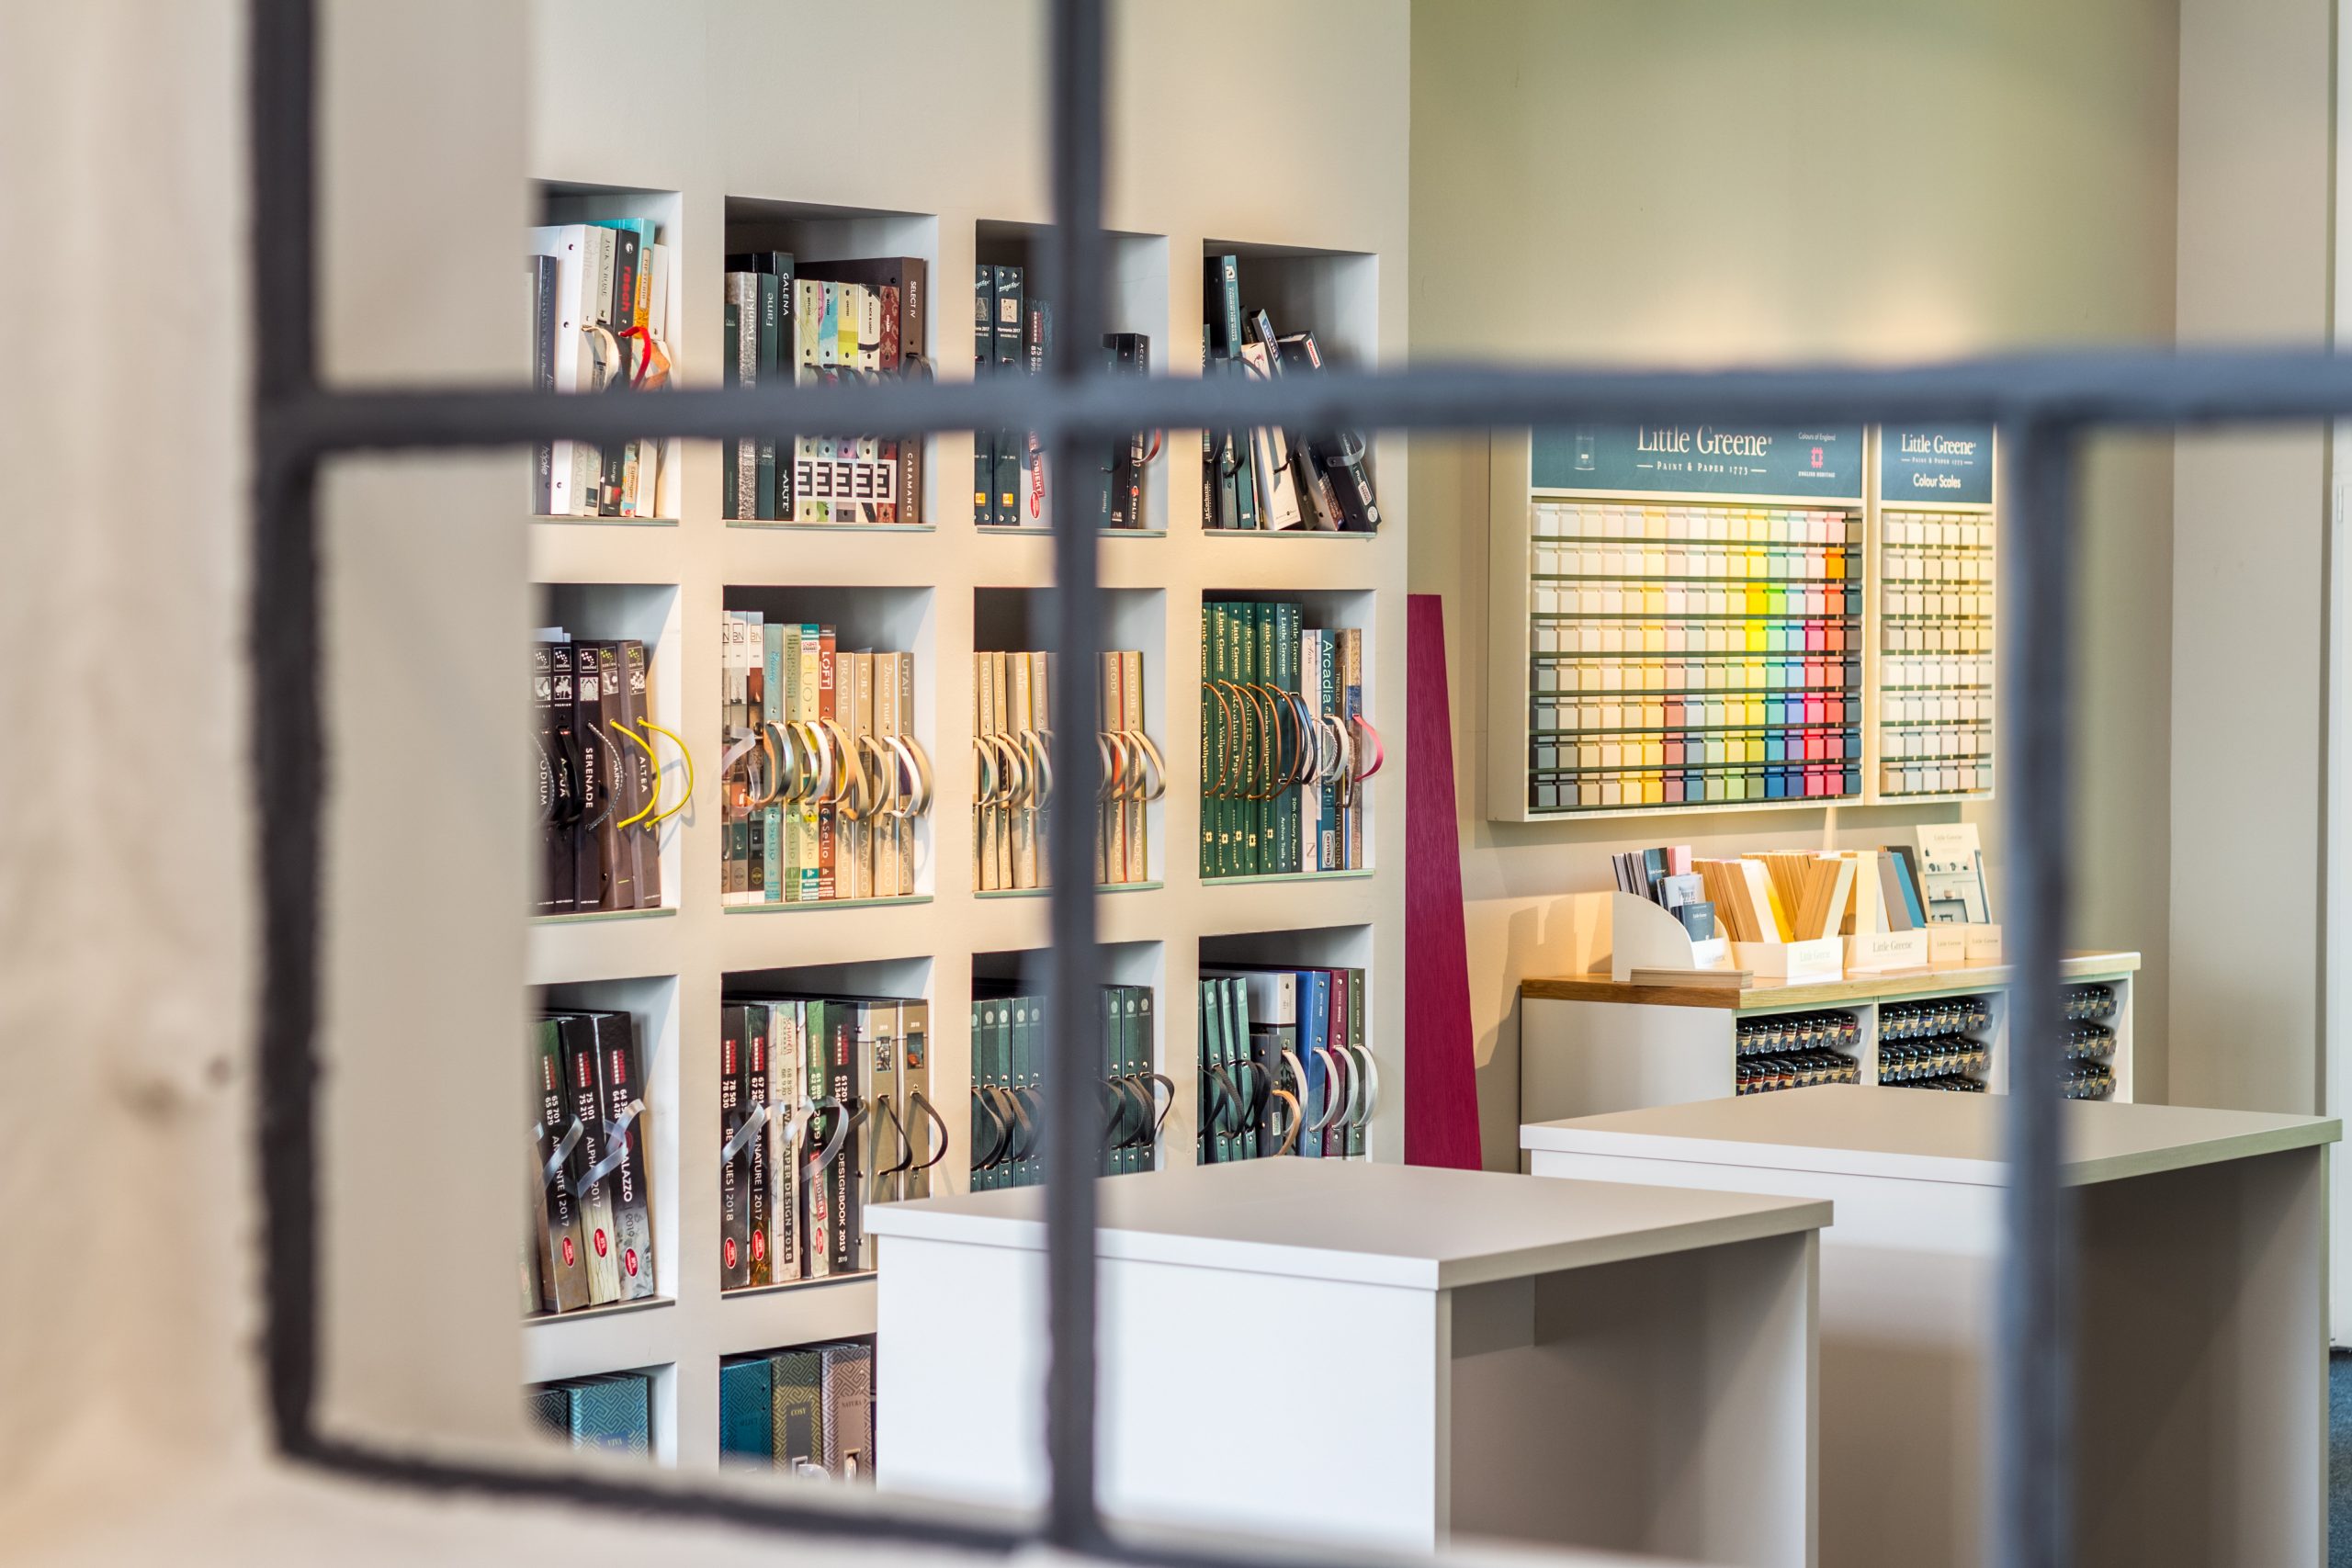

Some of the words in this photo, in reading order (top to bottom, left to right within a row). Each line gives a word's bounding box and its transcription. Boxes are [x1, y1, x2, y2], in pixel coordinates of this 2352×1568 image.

[782, 272, 790, 317] GALENA
[746, 290, 756, 341] Twinkle
[765, 292, 775, 327] Fame
[1031, 345, 1037, 356] 85
[1637, 424, 1690, 454] Little
[1798, 432, 1814, 440] Colours
[1820, 434, 1837, 442] England
[1901, 434, 1931, 454] Little
[1933, 434, 1973, 456] Greene
[906, 452, 914, 518] CASAMANCE
[1913, 472, 1938, 488] Colour
[1939, 472, 1962, 489] Scales
[821, 651, 831, 686] LOFT
[1322, 639, 1334, 686] Arcadia
[801, 656, 818, 702] duo
[841, 660, 850, 714] PRAGUE
[901, 658, 910, 697] UTAH
[982, 660, 990, 721] EQUINOXE
[1263, 735, 1272, 780] Wallpapers
[585, 748, 594, 808] SERENADE
[639, 756, 648, 794] ALTEA
[882, 826, 892, 888] CASADECO
[900, 826, 910, 887] CASADECO
[1114, 817, 1123, 875] CASADECO
[1133, 817, 1142, 875] CASADECO
[841, 829, 849, 892] CASADECO
[861, 830, 869, 892] CASADECO
[1872, 941, 1890, 953] Little
[1891, 939, 1914, 951] Greene
[722, 1080, 729, 1092] 78
[729, 1079, 736, 1091] 78
[752, 1077, 758, 1089] 67
[758, 1076, 764, 1089] 67
[816, 1072, 822, 1082] 61
[545, 1097, 552, 1108] 65
[551, 1095, 559, 1106] 65
[579, 1093, 586, 1105] 75
[585, 1091, 594, 1103] 75
[613, 1089, 620, 1101] 64
[619, 1089, 628, 1100] 64
[545, 1110, 554, 1125] 829
[552, 1108, 560, 1123] 701
[580, 1106, 588, 1122] 211
[587, 1105, 595, 1121] 101
[613, 1102, 621, 1119] 478
[813, 1109, 821, 1140] 2019
[783, 1109, 792, 1179] WAPAPER
[754, 1143, 763, 1186] NATURE
[590, 1181, 602, 1208] 2017
[838, 1152, 846, 1226] DESIGNBOOK
[560, 1201, 570, 1227] 2017
[726, 1194, 734, 1222] 2018
[754, 1194, 763, 1221] 2017
[784, 1181, 792, 1227] DESIGN
[625, 1213, 636, 1237] 2019
